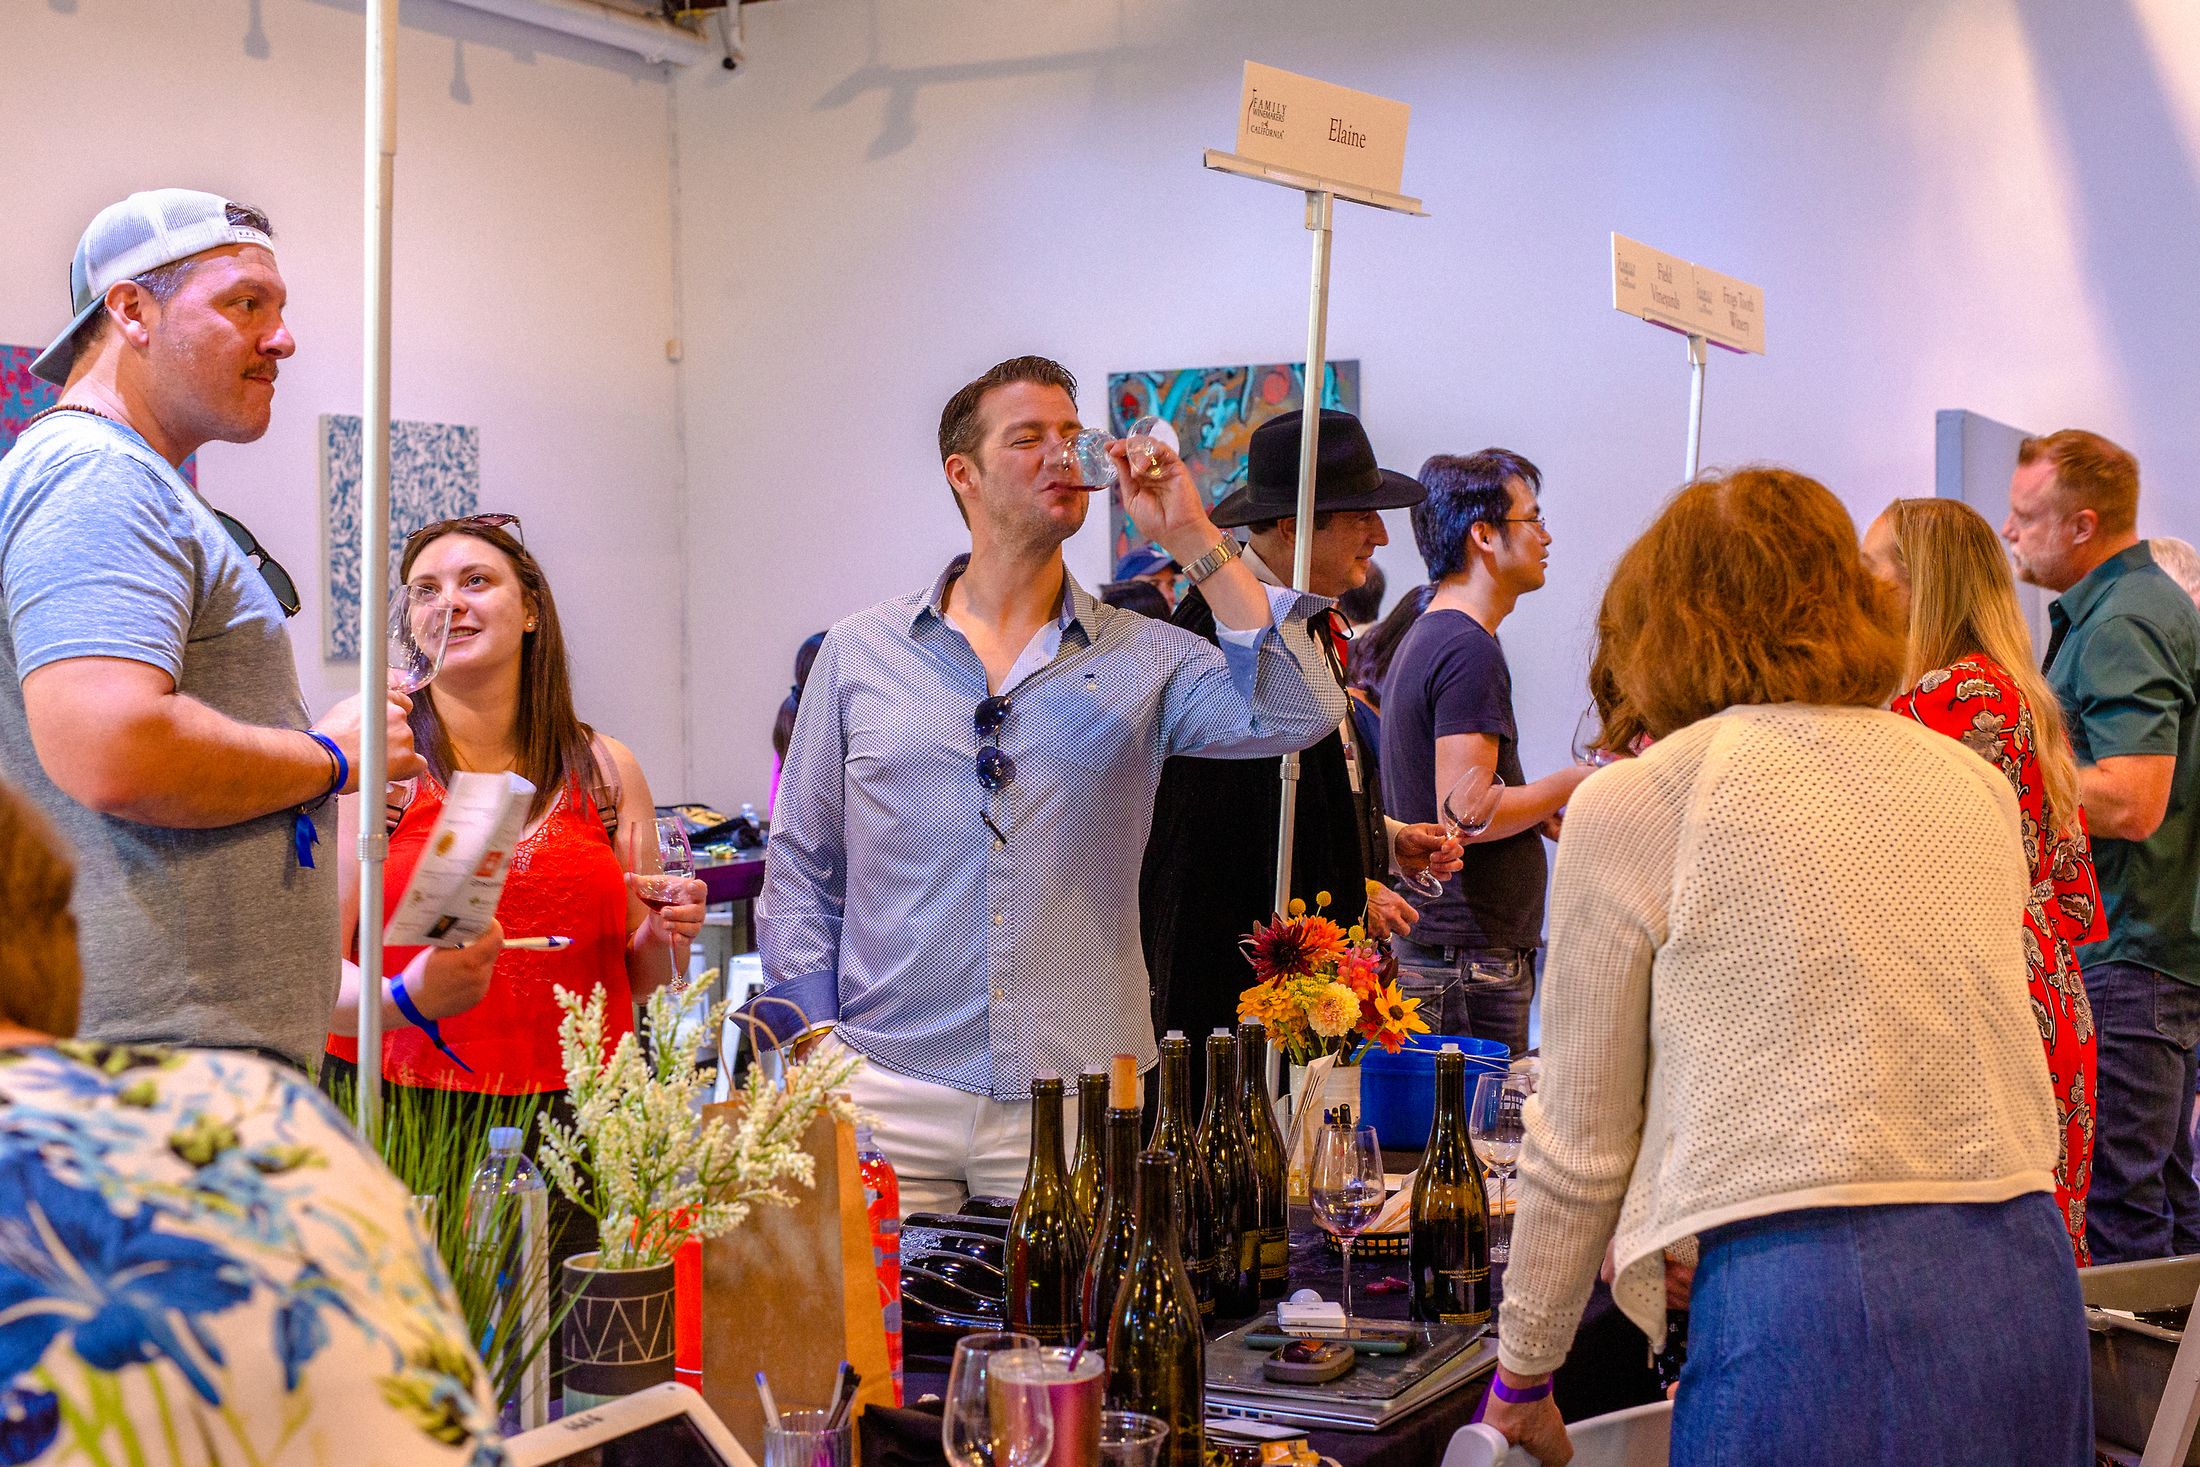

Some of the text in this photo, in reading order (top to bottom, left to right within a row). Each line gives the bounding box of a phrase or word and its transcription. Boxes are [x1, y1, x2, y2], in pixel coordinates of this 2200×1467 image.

[1253, 98, 1287, 114] FAMILY
[1252, 109, 1285, 122] WINEMAKERS
[1251, 125, 1284, 139] CALIFORNIA
[1329, 118, 1366, 148] Elaine
